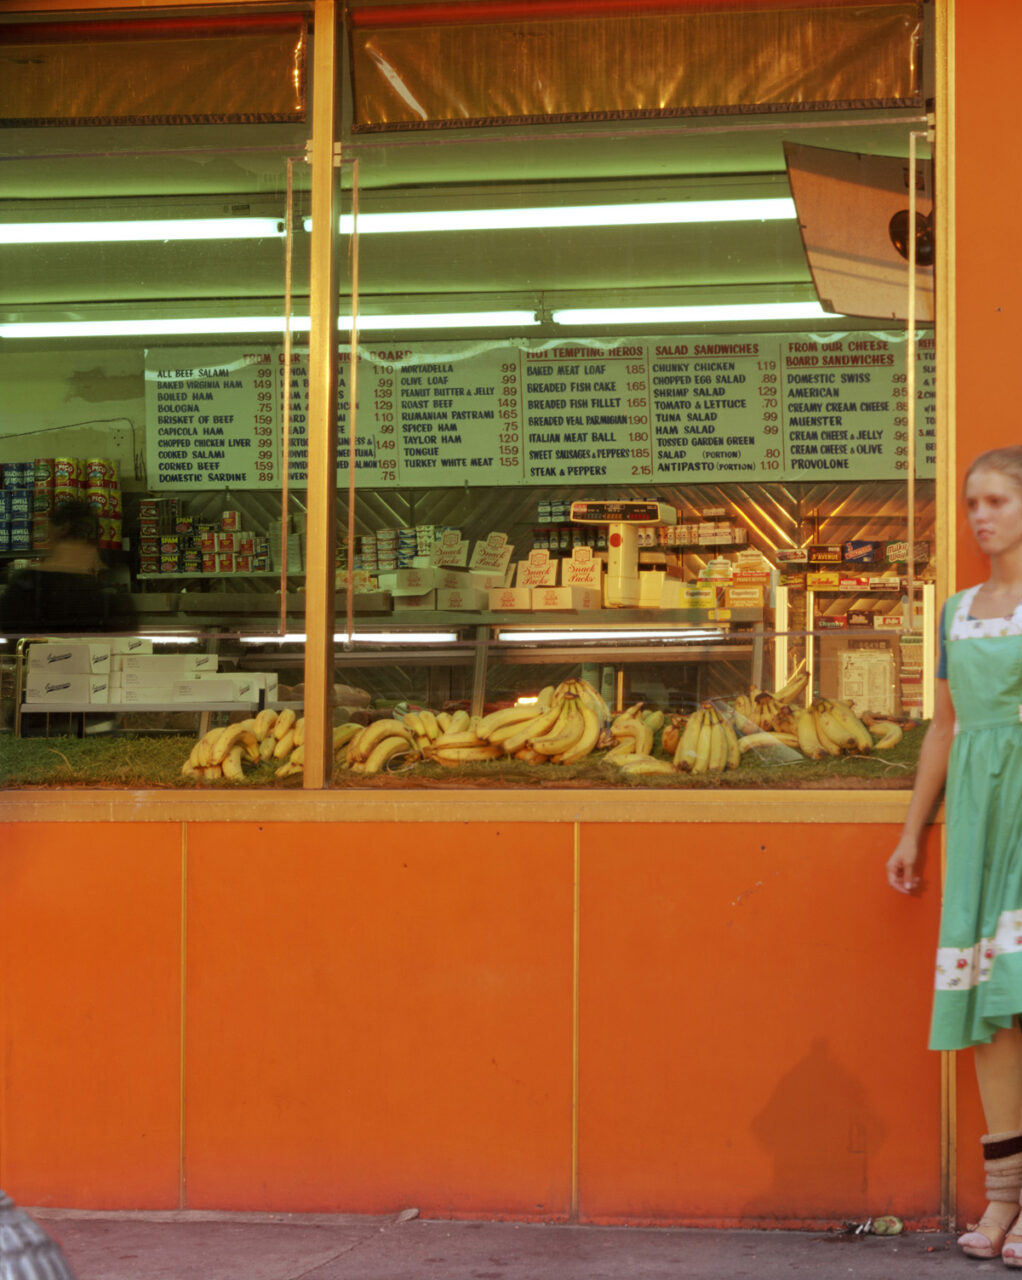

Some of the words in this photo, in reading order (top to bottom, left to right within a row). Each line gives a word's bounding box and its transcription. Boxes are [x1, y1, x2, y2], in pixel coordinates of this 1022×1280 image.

[656, 345, 688, 355] SALAD
[694, 343, 759, 353] SANDWICHES
[789, 342, 818, 352] FROM
[822, 342, 843, 352] OUR
[848, 341, 888, 351] CHEESE
[554, 348, 604, 358] TEMPTING
[609, 346, 643, 356] HEROS
[786, 356, 818, 366] BOARD
[822, 354, 895, 365] SANDWICHES
[401, 365, 453, 373] MORTADELLA
[527, 366, 553, 376] BAKED
[557, 365, 580, 375] MEAT
[584, 365, 606, 374] LOAF
[652, 363, 689, 372] CHUNKY
[694, 362, 735, 371] CHICKEN
[157, 369, 172, 378] ALL
[176, 369, 194, 378] BEEF
[198, 369, 229, 378] SALAMI
[787, 374, 835, 384] DOMESTIC
[841, 373, 870, 383] SWISS
[157, 381, 184, 389] BAKED
[187, 381, 220, 389] VIRGINIA
[224, 380, 243, 389] HAM
[400, 377, 422, 385] OLIVE
[428, 376, 448, 385] LOAF
[653, 376, 691, 385] CHOPPED
[695, 375, 712, 384] EGG
[716, 374, 746, 384] SALAD
[401, 388, 430, 397] PEANUT
[434, 388, 464, 396] BUTTER
[474, 387, 495, 395] JELLY
[527, 383, 566, 393] BREADED
[570, 382, 591, 391] FISH
[594, 382, 616, 391] CAKE
[654, 388, 689, 398] SHRIMP
[693, 387, 725, 397] SALAD
[158, 393, 187, 401] BOILED
[192, 392, 213, 400] HAM
[788, 388, 839, 398] AMERICAN
[158, 404, 200, 412] BOLOGNA
[401, 400, 428, 409] ROAST
[433, 400, 453, 408] BEEF
[528, 400, 567, 409] BREADED
[570, 399, 588, 408] FISH
[592, 398, 621, 407] FILLET
[655, 401, 691, 410] TOMATO
[704, 399, 747, 408] LETTUCE
[788, 403, 822, 412] CREAMY
[826, 402, 857, 412] CREAM
[860, 401, 889, 411] CHEESE
[158, 416, 194, 424] BRISKET
[198, 416, 210, 424] OF
[213, 415, 234, 424] BEEF
[402, 412, 447, 421] RUMANIAN
[452, 411, 494, 419] PASTRAMI
[528, 416, 564, 426] BREADED
[566, 416, 584, 425] VEAL
[656, 414, 681, 422] TUNA
[687, 412, 717, 421] SALAD
[789, 416, 842, 426] MUENSTER
[158, 428, 198, 436] CAPICOLA
[402, 424, 433, 432] SPICED
[656, 426, 679, 435] HAM
[684, 425, 715, 434] SALAD
[403, 436, 437, 444] TAYLOR
[529, 434, 560, 443] ITALIAN
[564, 433, 588, 442] MEAT
[592, 432, 616, 442] BALL
[789, 431, 818, 441] CREAM
[821, 430, 848, 440] CHEESE
[856, 430, 883, 440] JELLY
[158, 439, 190, 447] CHOPPED
[194, 439, 225, 447] CHICKEN
[228, 439, 251, 447] LIVER
[657, 438, 688, 447] TOSSED
[692, 437, 724, 446] GARDEN
[726, 436, 755, 445] GREEN
[404, 448, 439, 456] TONGUE
[790, 445, 818, 454] CREAM
[820, 444, 847, 454] CHEESE
[856, 444, 883, 454] OLIVE
[158, 451, 187, 459] COOKED
[192, 451, 225, 459] SALAMI
[529, 450, 553, 460] SWEET
[556, 449, 590, 459] SAUSAGES
[597, 449, 630, 458] PEPPERS
[658, 450, 686, 459] SALAD
[159, 462, 193, 471] CORNED
[197, 462, 220, 470] BEEF
[405, 459, 437, 468] TURKEY
[442, 459, 466, 467] WHITE
[471, 458, 493, 466] MEAT
[658, 462, 714, 472] ANTIPASTO
[791, 459, 849, 469] PROVOLONE
[530, 467, 556, 476] STEAK
[567, 466, 607, 476] PEPPERS
[159, 474, 202, 483] DOMESTIC
[208, 473, 247, 481] SARDINE
